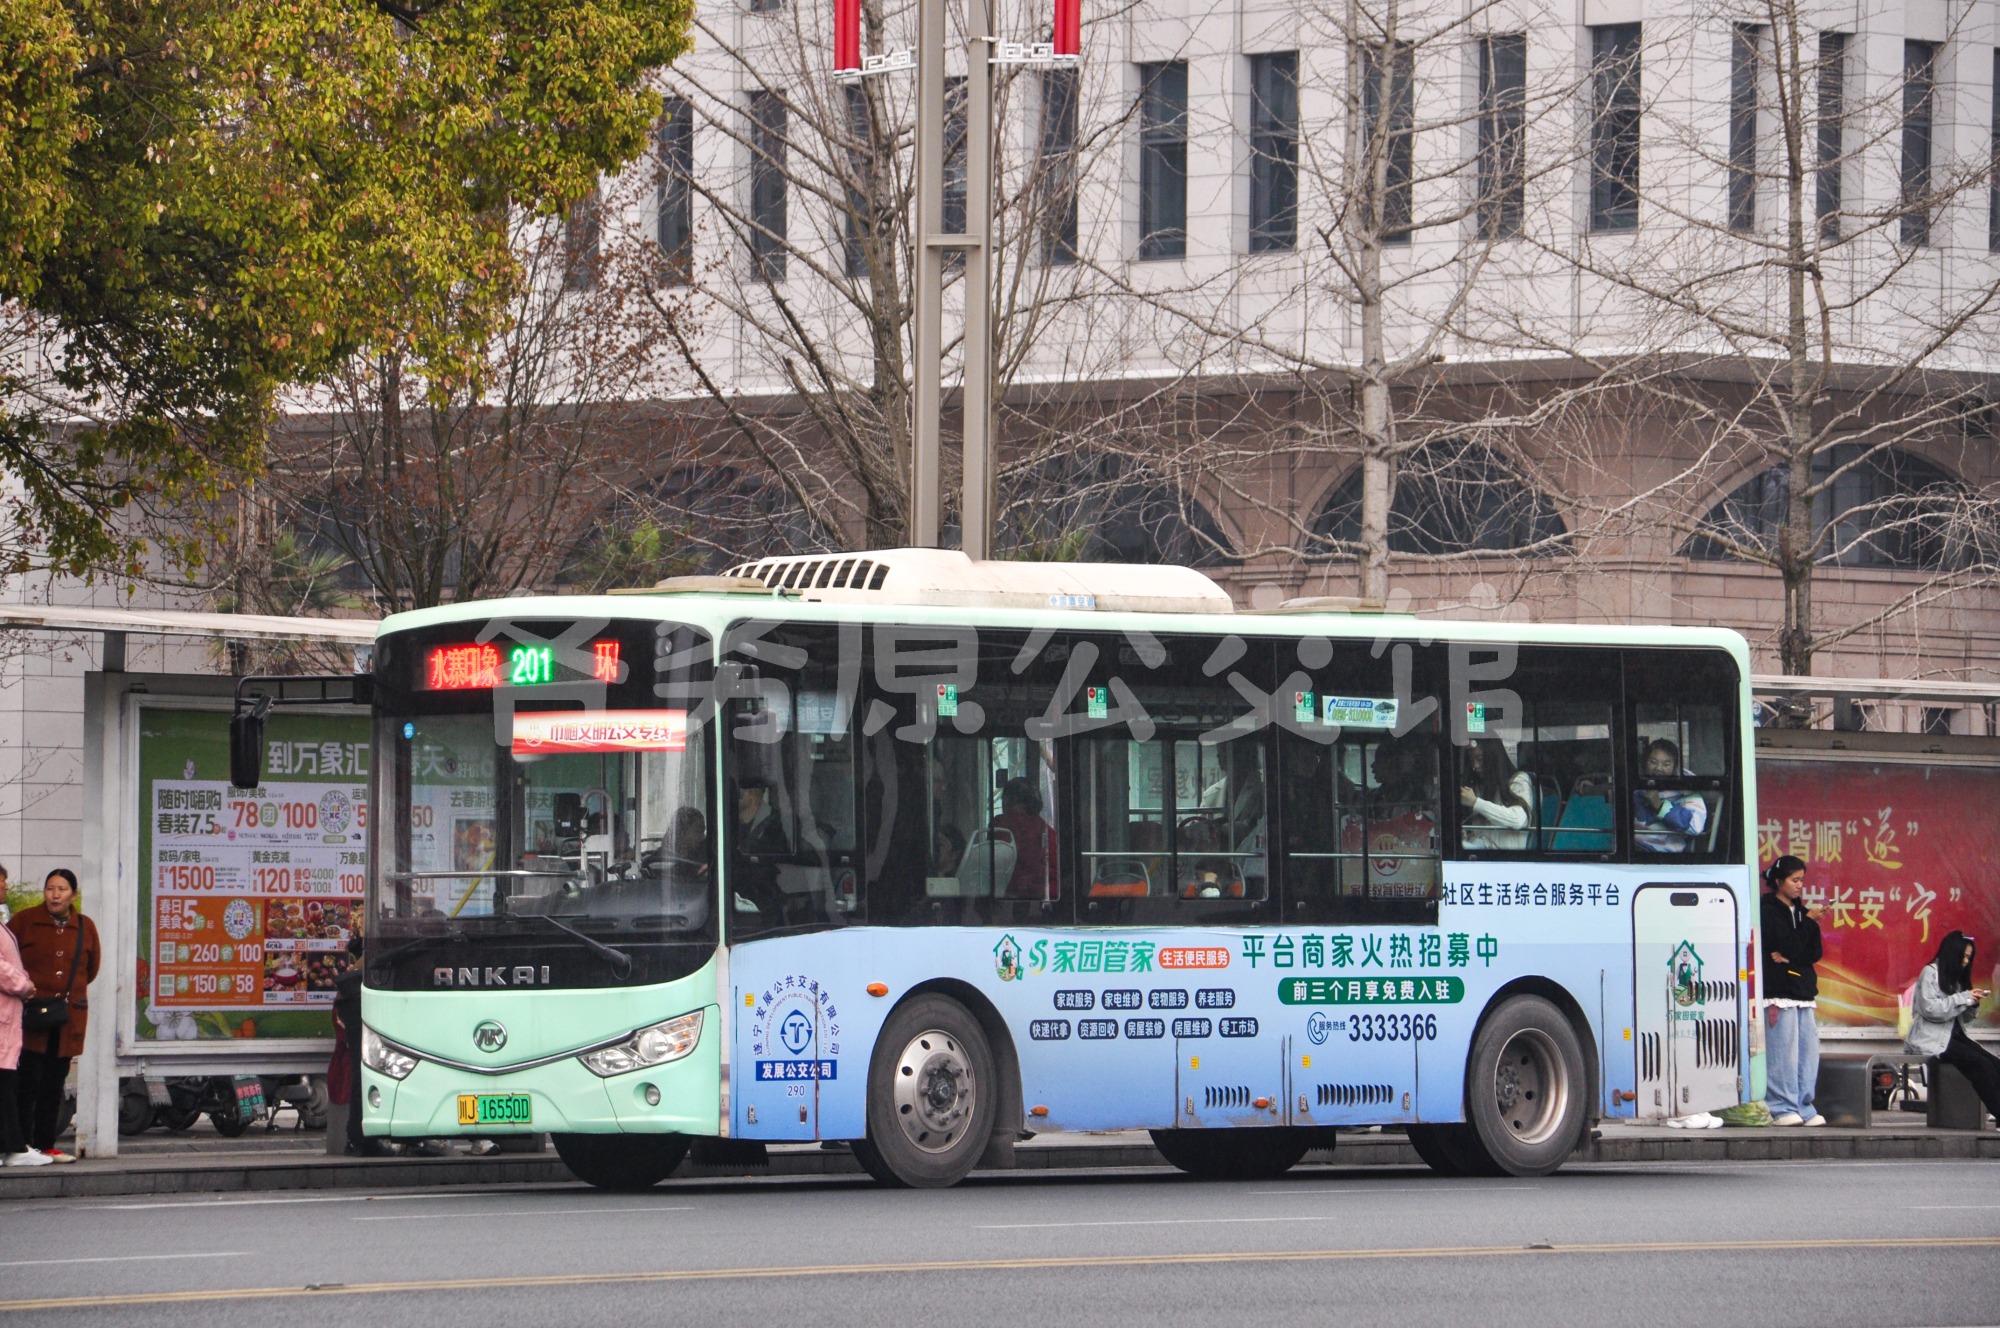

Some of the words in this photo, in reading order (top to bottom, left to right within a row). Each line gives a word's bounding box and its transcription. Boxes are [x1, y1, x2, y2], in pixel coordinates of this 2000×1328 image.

[430, 645, 499, 689] 水寨印象
[511, 647, 551, 685] 201
[549, 722, 671, 743] 巾帼文明公交专线
[268, 741, 369, 776] 到万象汇
[157, 789, 222, 811] 随时嗨购
[227, 787, 267, 799] 服饰/美妆
[158, 851, 201, 863] 数码/家电
[252, 851, 290, 864] 黄金克减
[1442, 882, 1620, 907] 社区生活综合服务平台
[160, 899, 182, 914] 春日
[160, 914, 182, 930] 美食
[1161, 949, 1229, 968] 生活便民服务
[1242, 932, 1499, 970] 平台商家火热招募中
[433, 965, 550, 986] ANKAI
[1056, 991, 1093, 1008] 家政服务
[1104, 991, 1141, 1008] 家电维修
[1150, 990, 1187, 1008] 宠物服务
[1197, 990, 1234, 1007] 养老服务
[1292, 980, 1451, 1003] 前三个月享免费入驻
[753, 974, 840, 1056] 遂宁发展公共交通有限公司
[1032, 1021, 1068, 1038] 快递代拿
[1080, 1021, 1116, 1038] 资源回收
[1127, 1020, 1163, 1037] 房屋装修
[1174, 1020, 1210, 1037] 房屋维修
[1221, 1019, 1256, 1036] 零工市场
[1318, 1021, 1346, 1033] 服务热线
[1348, 1014, 1438, 1042] 3333366
[762, 1062, 832, 1079] 发展公交公司
[787, 1085, 805, 1097] 290
